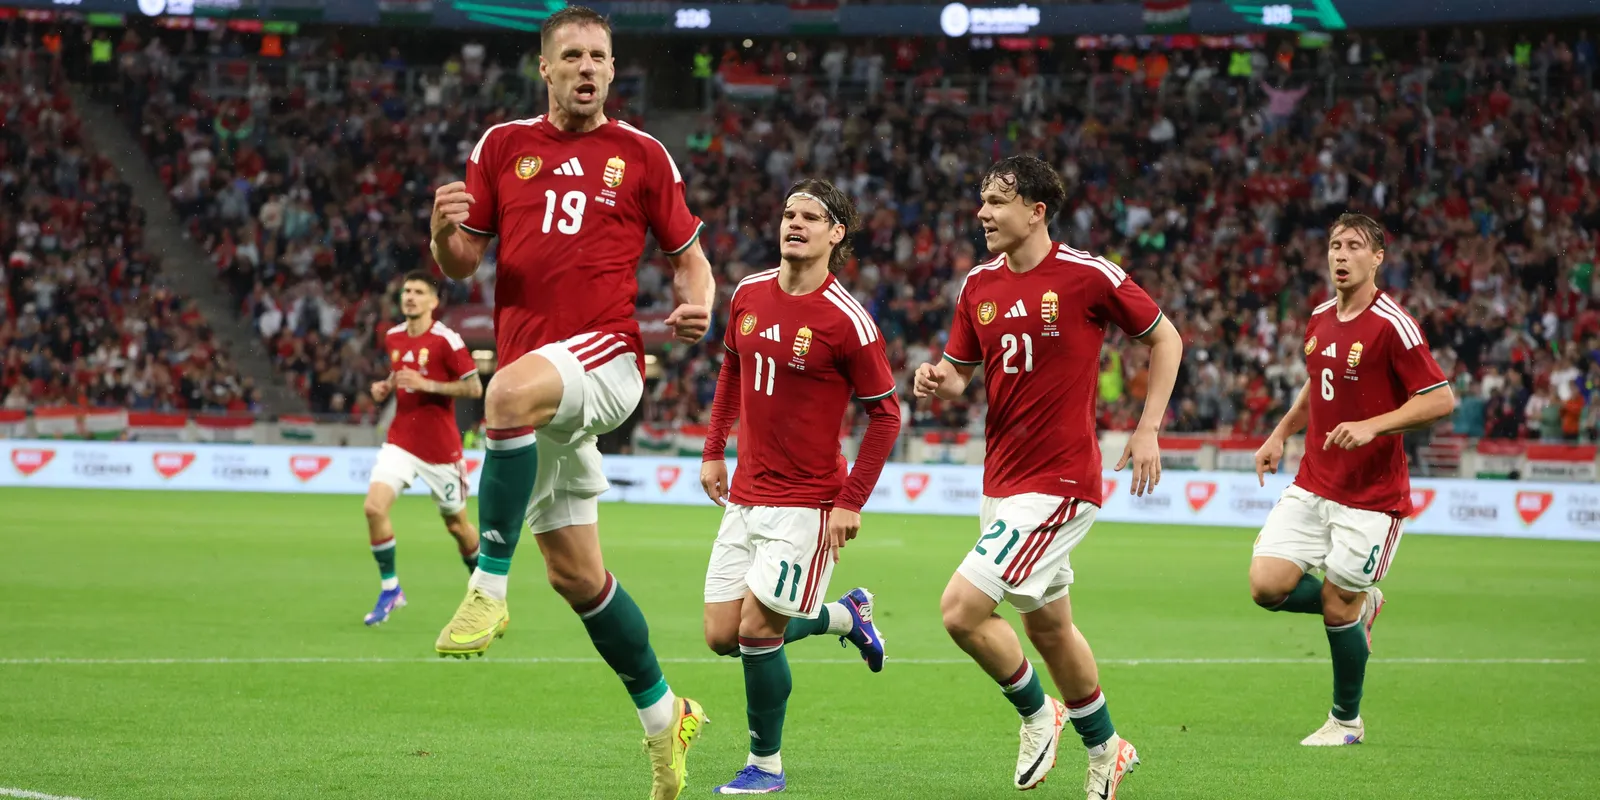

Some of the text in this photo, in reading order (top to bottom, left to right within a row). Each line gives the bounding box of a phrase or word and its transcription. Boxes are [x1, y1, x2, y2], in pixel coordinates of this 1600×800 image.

[542, 190, 586, 235] 19
[754, 352, 776, 396] 11
[1001, 333, 1033, 374] 21
[1321, 368, 1334, 401] 6
[445, 483, 455, 501] 2
[975, 519, 1020, 565] 21
[1363, 545, 1380, 574] 6
[774, 560, 802, 602] 11
